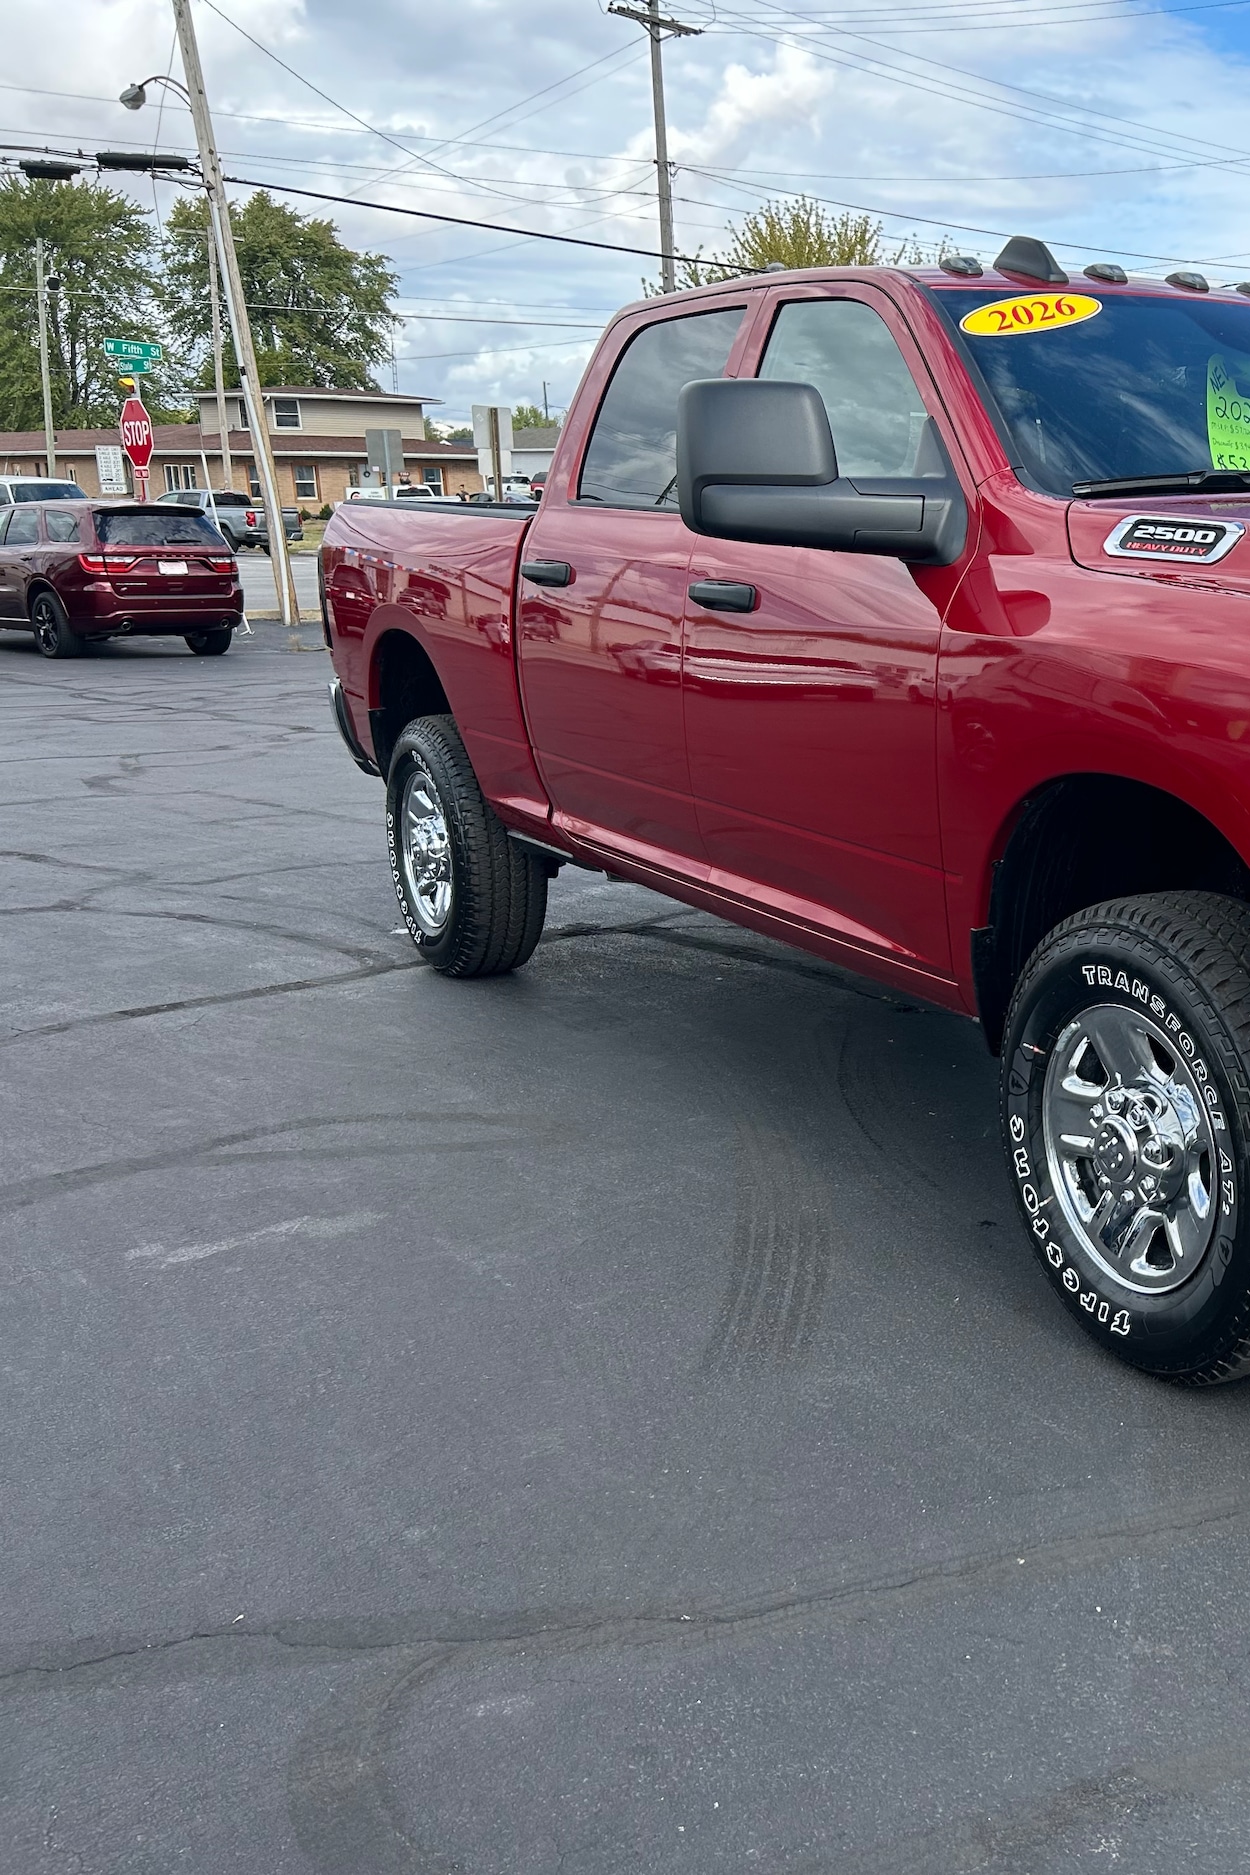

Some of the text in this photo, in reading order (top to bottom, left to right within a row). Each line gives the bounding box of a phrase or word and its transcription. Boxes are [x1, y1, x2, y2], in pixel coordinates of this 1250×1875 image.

[988, 296, 1076, 332] 2026
[106, 341, 160, 357] W Fifth St
[123, 420, 150, 447] STOP
[1125, 541, 1208, 555] HEAVY DUTY
[1133, 525, 1217, 544] 2500
[1081, 964, 1227, 1132] TRANSFORCE
[1009, 1113, 1132, 1336] Firestone
